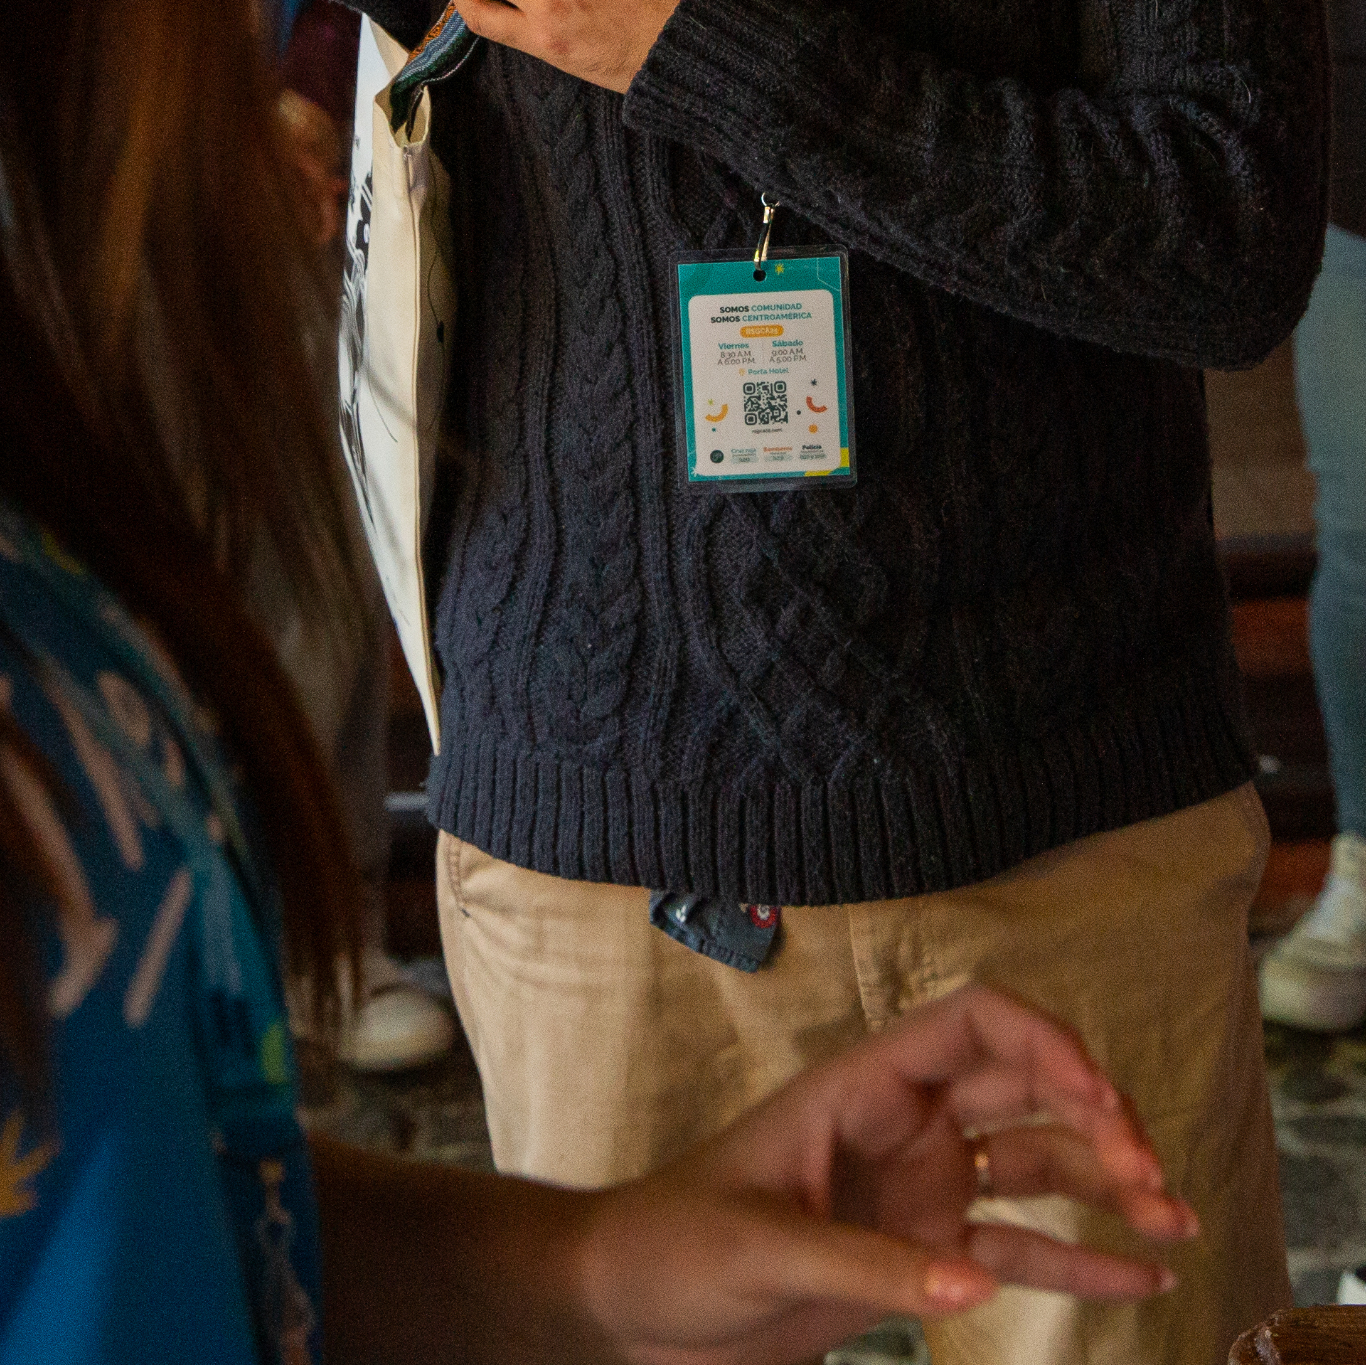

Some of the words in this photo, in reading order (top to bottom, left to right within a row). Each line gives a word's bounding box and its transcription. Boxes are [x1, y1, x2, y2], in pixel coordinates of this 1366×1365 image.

[719, 305, 750, 314] SOMOS
[751, 302, 803, 312] COMUNIDAD
[710, 315, 741, 324] SOMOS
[742, 312, 813, 322] CENTROAMÉRICA
[718, 342, 749, 350] Viernes
[772, 339, 804, 347] Sábado
